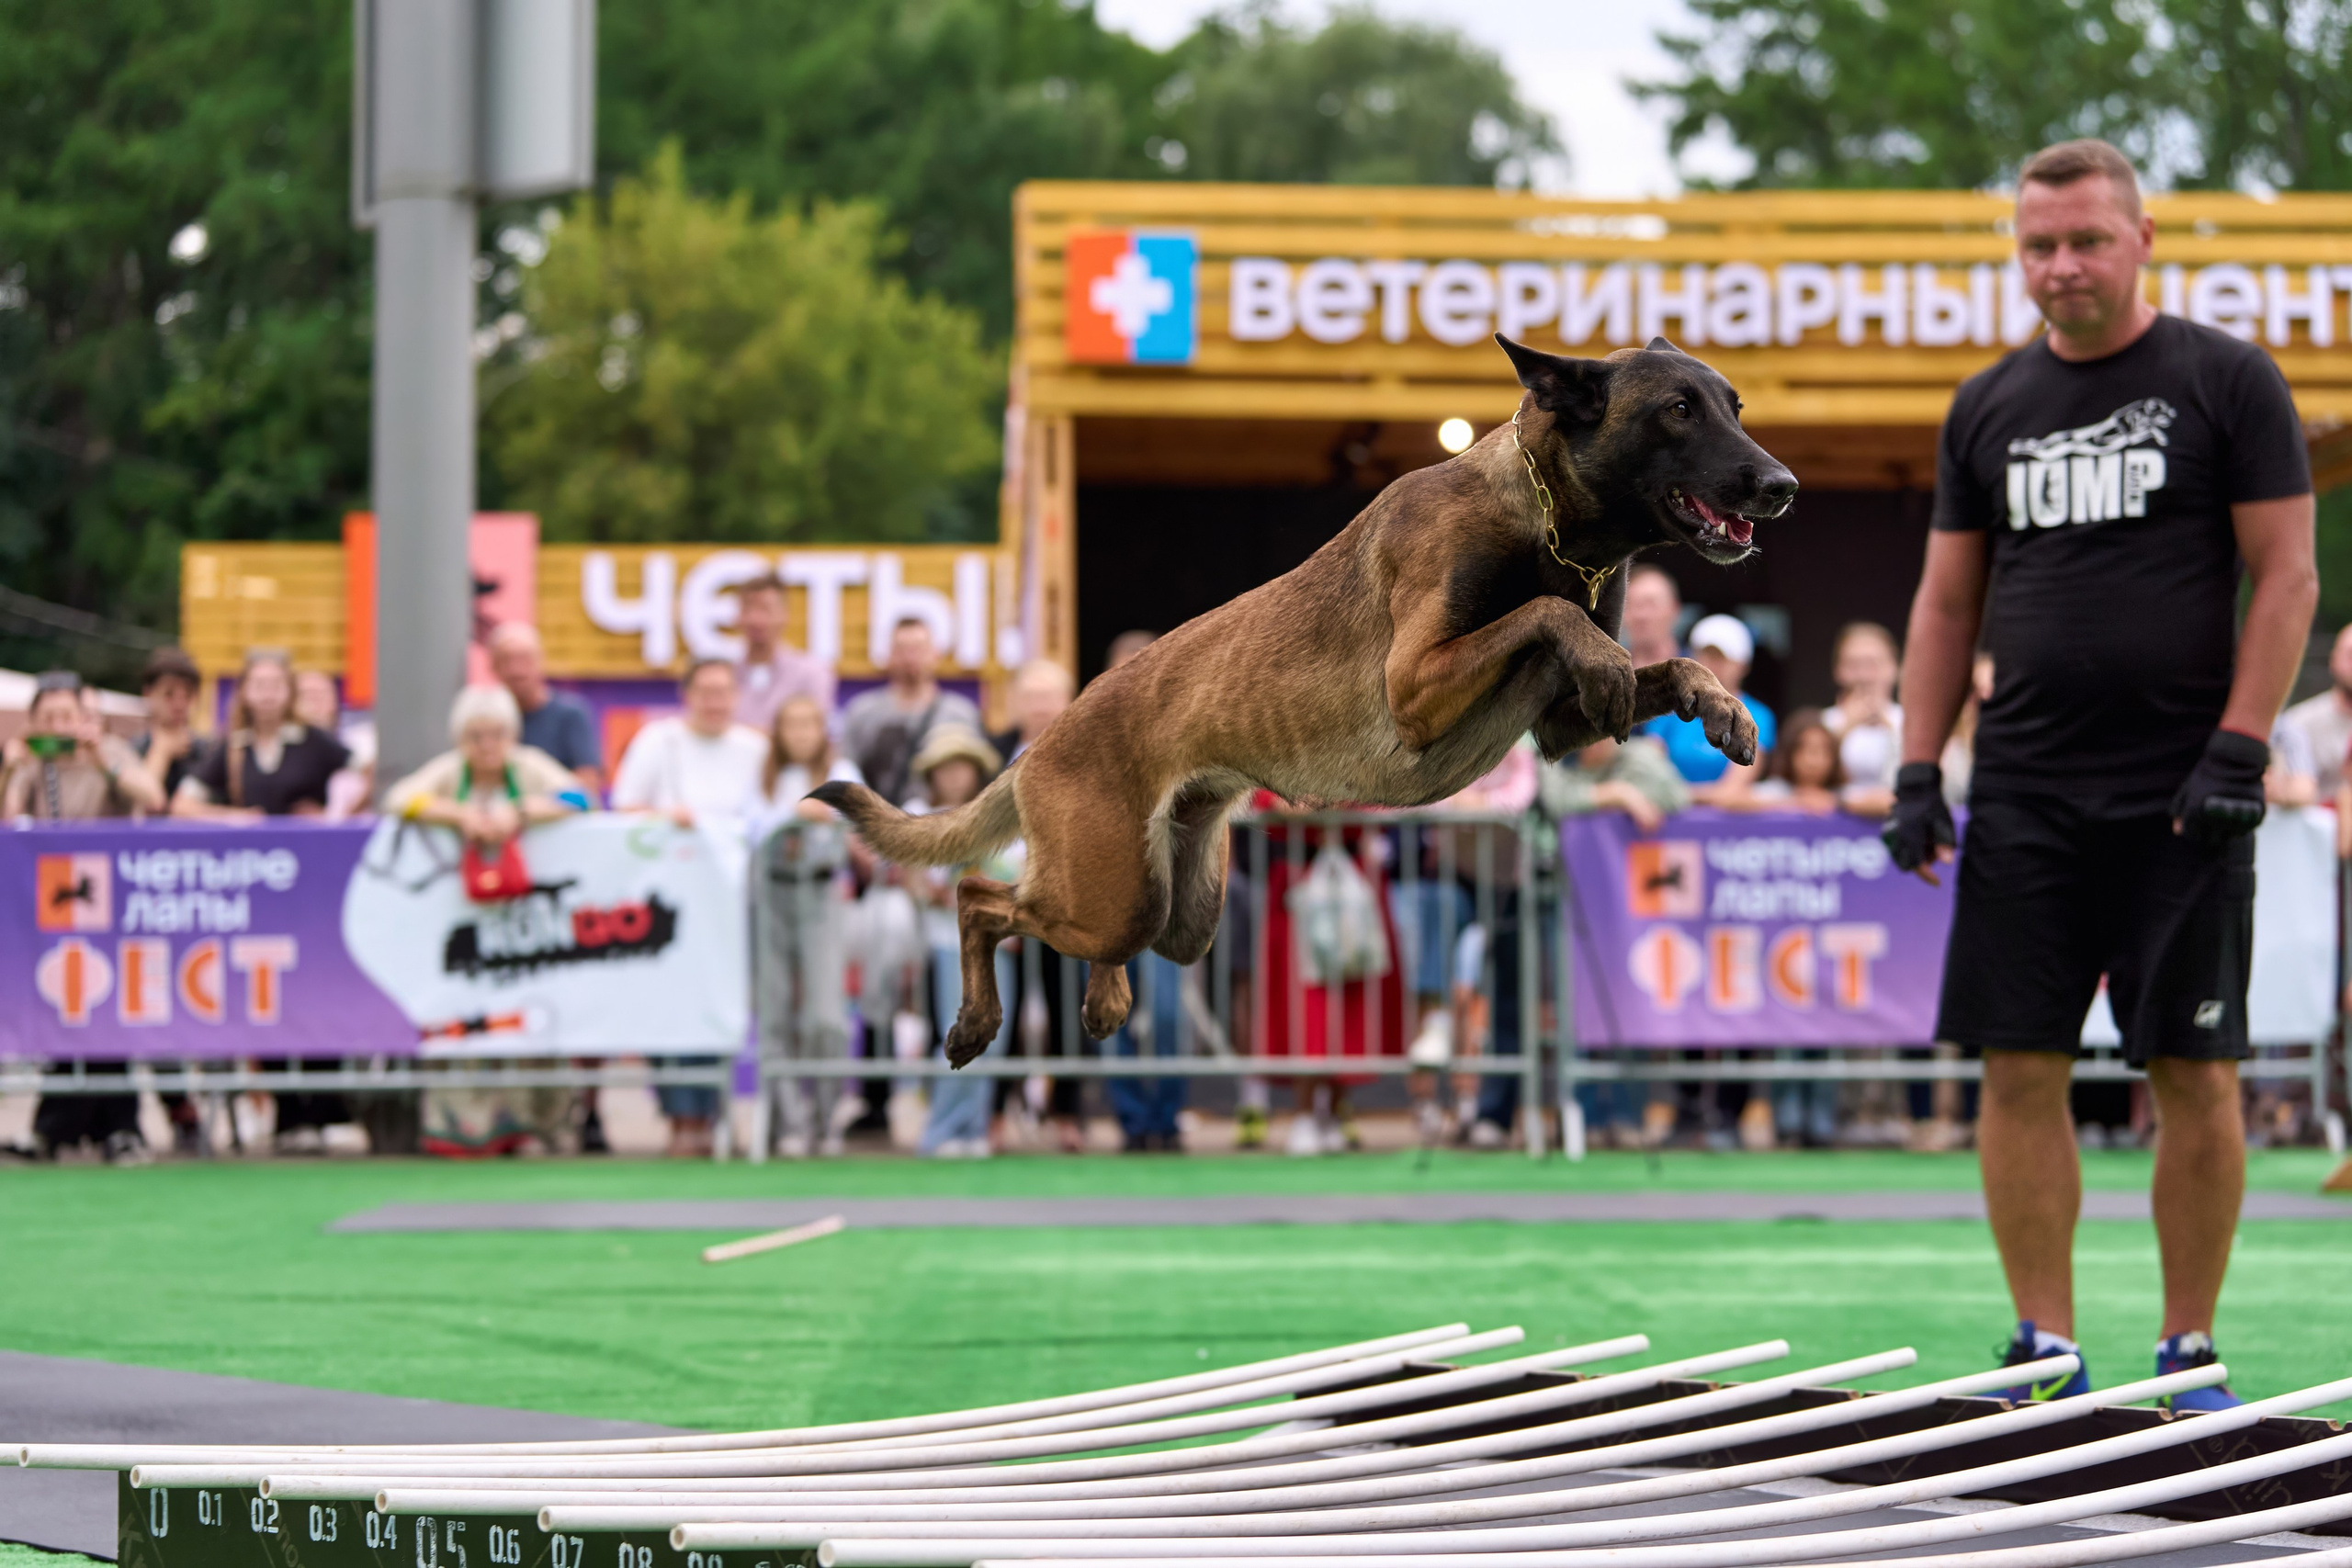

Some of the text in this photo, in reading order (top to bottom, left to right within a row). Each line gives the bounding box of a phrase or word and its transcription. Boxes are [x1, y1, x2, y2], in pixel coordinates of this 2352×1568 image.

[2007, 448, 2166, 531] JUMP
[36, 935, 298, 1027] ФЕСТ
[1627, 922, 1889, 1013] ФЕСТ
[150, 1488, 168, 1538] 0
[198, 1490, 222, 1526] 0.1
[251, 1497, 279, 1533] 0.2
[309, 1505, 337, 1541] 0.3
[366, 1511, 397, 1549] 0.4
[416, 1517, 467, 1568] 0.5
[489, 1525, 520, 1564] 0.6
